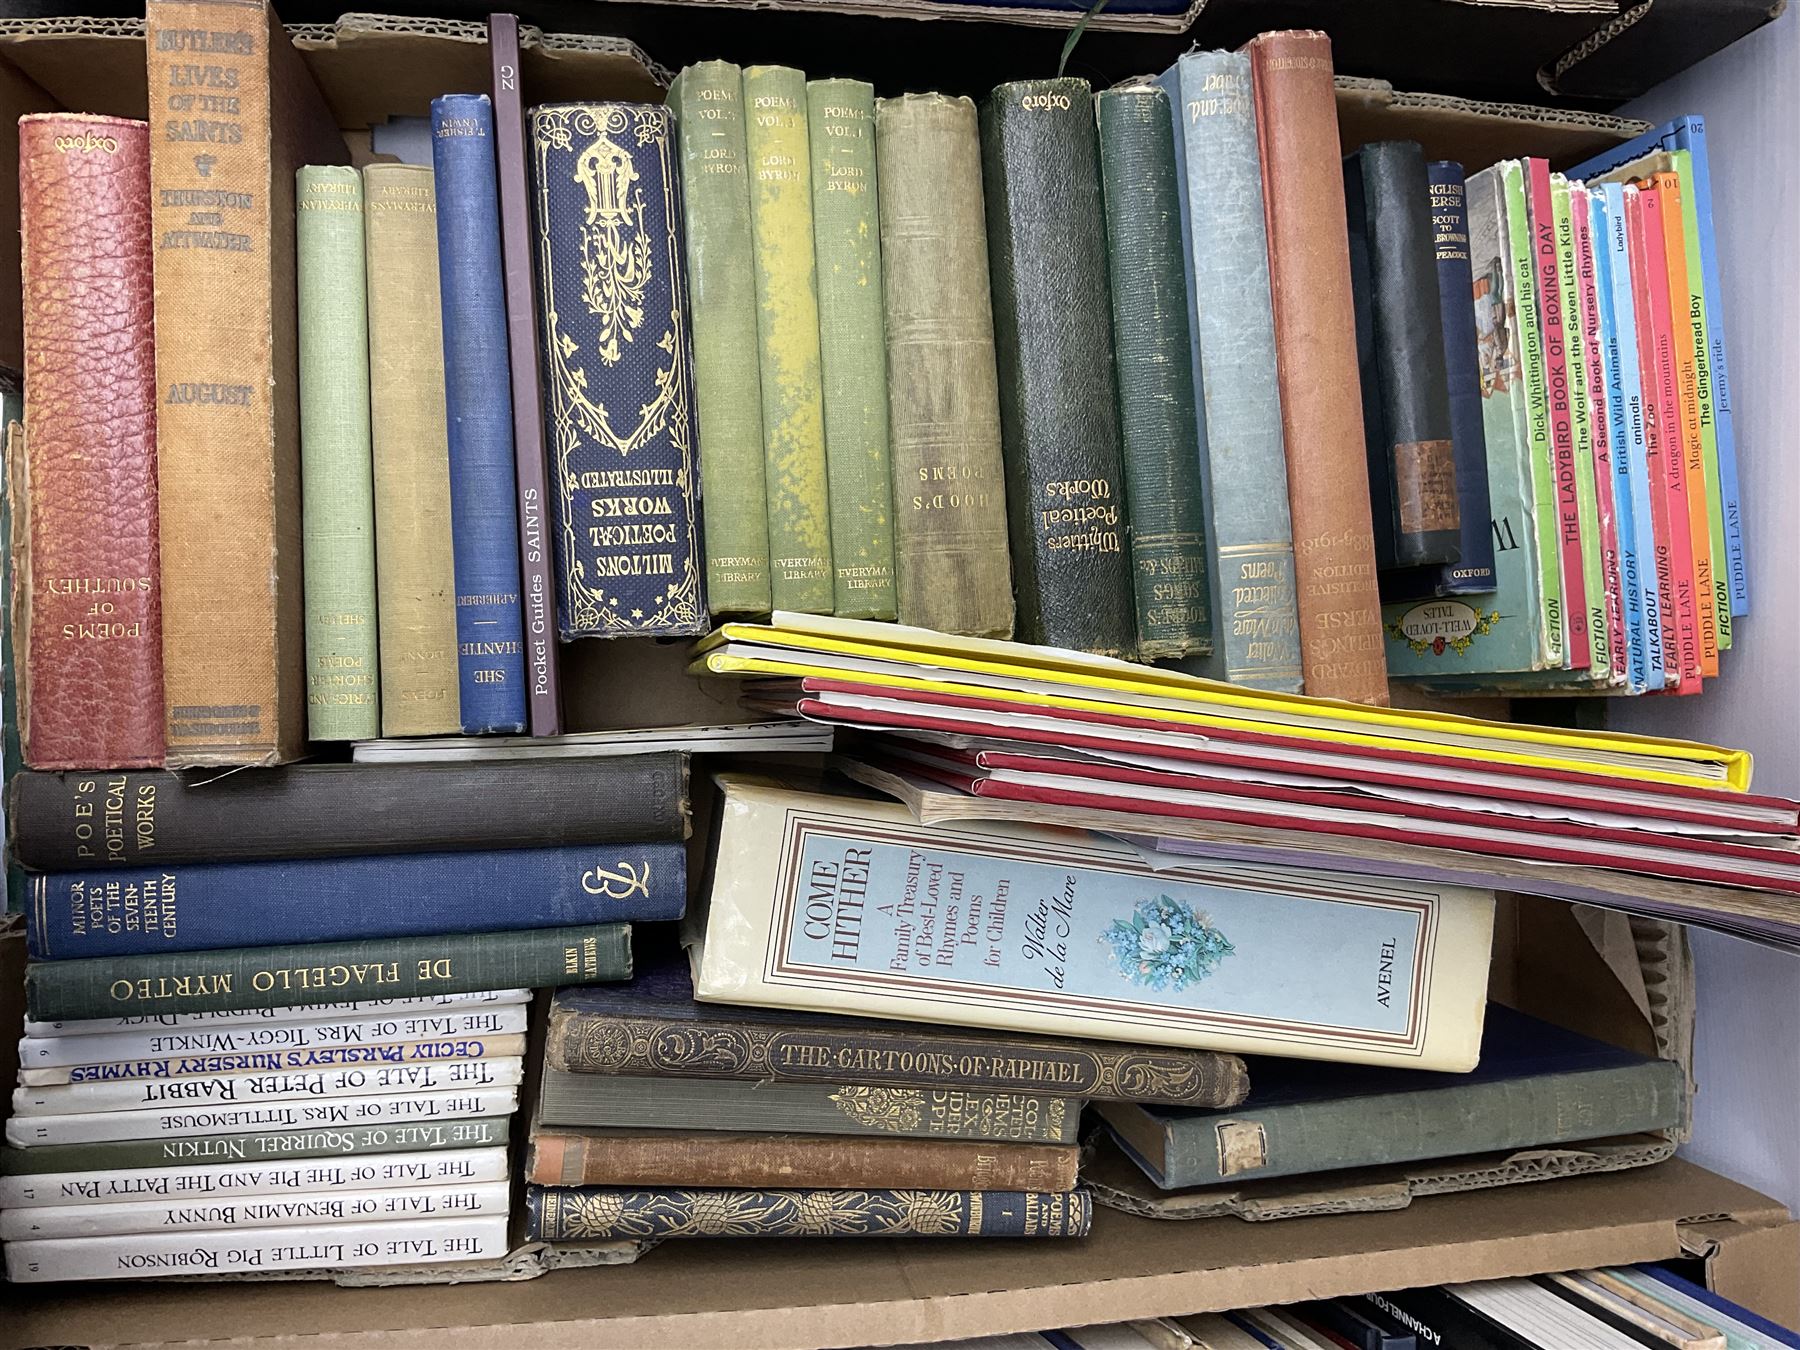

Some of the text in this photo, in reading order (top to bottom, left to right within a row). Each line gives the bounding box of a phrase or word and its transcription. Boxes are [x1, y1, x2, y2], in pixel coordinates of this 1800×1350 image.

[168, 66, 240, 89] LIVES
[168, 95, 241, 115] OF THE
[1022, 91, 1070, 112] Oxford
[54, 134, 118, 154] Oxford
[166, 121, 243, 144] SAINTS
[704, 149, 736, 159] LORD
[831, 167, 863, 177] LORD
[827, 180, 867, 193] BYRON
[1432, 215, 1460, 225] SCOTT
[1614, 216, 1625, 252] Ladybird
[1436, 251, 1468, 260] PEACOCK
[1518, 257, 1546, 442] Dick Whittington and his cat
[1559, 217, 1589, 453] The Wolf and the Seven Little Kids
[1690, 294, 1712, 428] The Gingerbread Boy
[1712, 338, 1732, 414] Jeremy's ride
[166, 383, 255, 407] AUGUST
[1539, 222, 1578, 545] THE LADYBIRD BOOK OF BOXING DAY
[1608, 336, 1627, 475] British Wild Animals
[1629, 395, 1643, 445] animals
[581, 469, 674, 489] ILLUSTRATED
[1046, 478, 1111, 500] Works
[591, 496, 672, 518] WORKS
[1042, 505, 1118, 530] Poetical
[589, 523, 677, 547] POETICAL
[45, 576, 152, 594] SOUTHEY
[847, 579, 891, 590] LIBRARY
[1312, 563, 1370, 578] EDITION
[1452, 567, 1491, 579] OXFORD
[88, 602, 115, 615] OF
[524, 487, 548, 696] Pocket Guides SAINTS
[1656, 545, 1678, 670] EARLY LEARNING
[1715, 580, 1731, 637] FICTION
[63, 622, 140, 640] POEMS
[1314, 609, 1377, 630] VERSE
[1405, 617, 1472, 636] WELL-LOVED
[1423, 605, 1455, 620] TALES
[1625, 550, 1646, 687] NATURAL HISTORY
[1645, 588, 1662, 672] TALKABOUT
[1678, 579, 1697, 680] PUDDLE LANE
[1591, 607, 1607, 665] FICTION
[474, 670, 506, 683] SHE
[104, 775, 127, 863] POETICAL
[136, 784, 156, 851] WORKS
[71, 880, 87, 936] MINOR
[89, 886, 104, 930] POETS
[106, 881, 121, 934] OF THE
[143, 879, 158, 935] TEENTH
[161, 872, 178, 939] CENTURY
[803, 860, 840, 941] COME
[831, 847, 873, 964] HITHER
[889, 849, 928, 973] Family Treasury
[914, 862, 944, 968] of Best-Loved
[935, 871, 966, 969] Rhymes and
[960, 894, 984, 947] Poems
[983, 878, 1011, 969] for Children
[1021, 897, 1050, 961] Walter
[1043, 873, 1078, 990] de la Mare
[110, 959, 453, 1000] DE FLAGELLO MYRTEO
[564, 946, 579, 975] ELKIN
[1376, 936, 1397, 1009] AVENEL
[150, 1014, 503, 1052] THE TALE OF MRS. TIGGY-WINKLE
[70, 1041, 485, 1083] CECILY PARSLEY'S NURSERY RHYMES
[990, 1057, 1086, 1085] RAPHAEL
[163, 1124, 494, 1160] THE TALE OF SQUIRREL NUTKIN
[60, 1160, 476, 1199] THE TALE OF THE PIE AND THE PATTY PAN
[1024, 1192, 1039, 1235] BALLADS
[1040, 1203, 1049, 1227] AND
[1048, 1193, 1063, 1236] POEMS
[117, 1237, 483, 1270] THE TALE OF LITTLE PIG ROBINSON
[1388, 1302, 1433, 1341] CHANNEL
[1433, 1331, 1441, 1346] A
